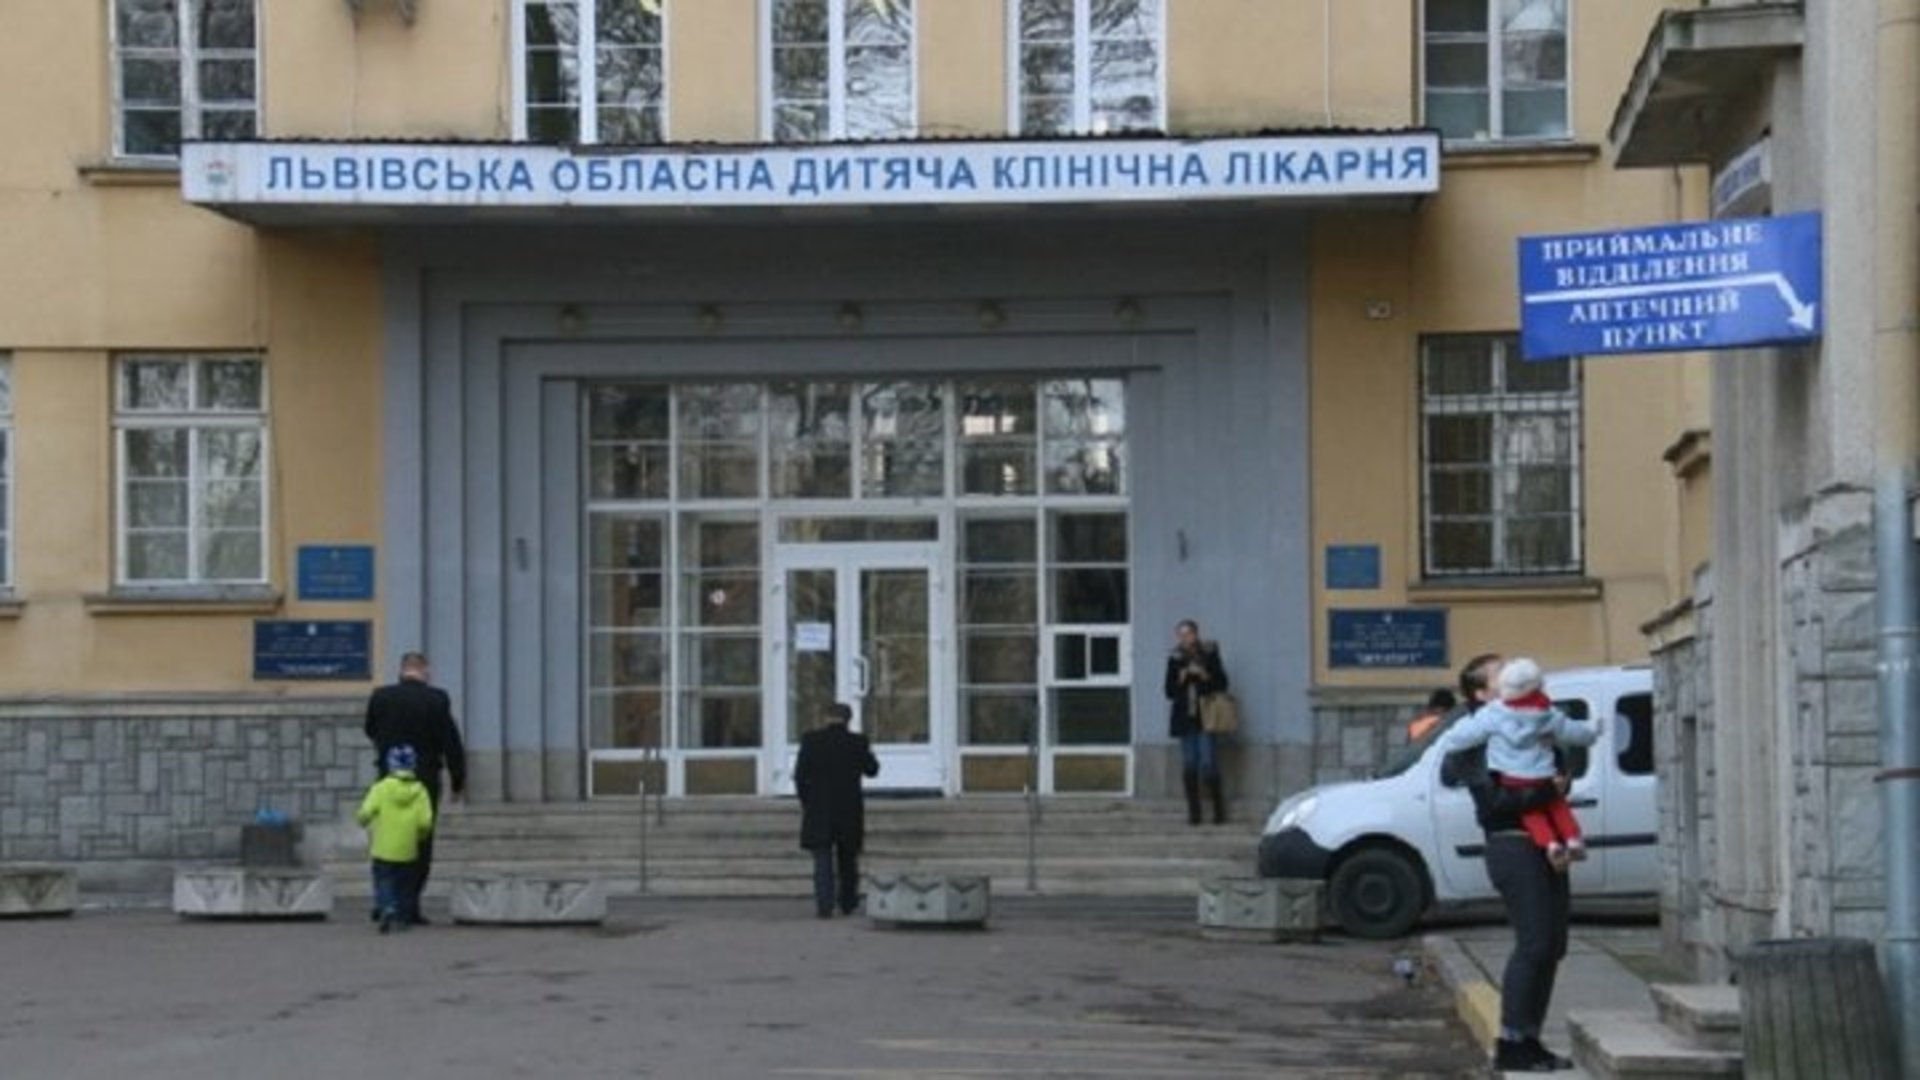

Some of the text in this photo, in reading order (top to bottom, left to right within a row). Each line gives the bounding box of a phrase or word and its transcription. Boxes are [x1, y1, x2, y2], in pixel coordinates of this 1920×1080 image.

[266, 146, 1429, 196] ЛЬВІВСЬКА ОБЛАСНА ДИТЯЧА КЛІНІЧНА ЛІКАРНЯ
[1542, 223, 1764, 261] ПРИЙМАЛЬНЕ
[1556, 252, 1750, 287] ВІДДІЛЕННЯ
[1569, 288, 1741, 323] АПТЕЧНИЙ
[1602, 320, 1708, 347] ПУНКТ
